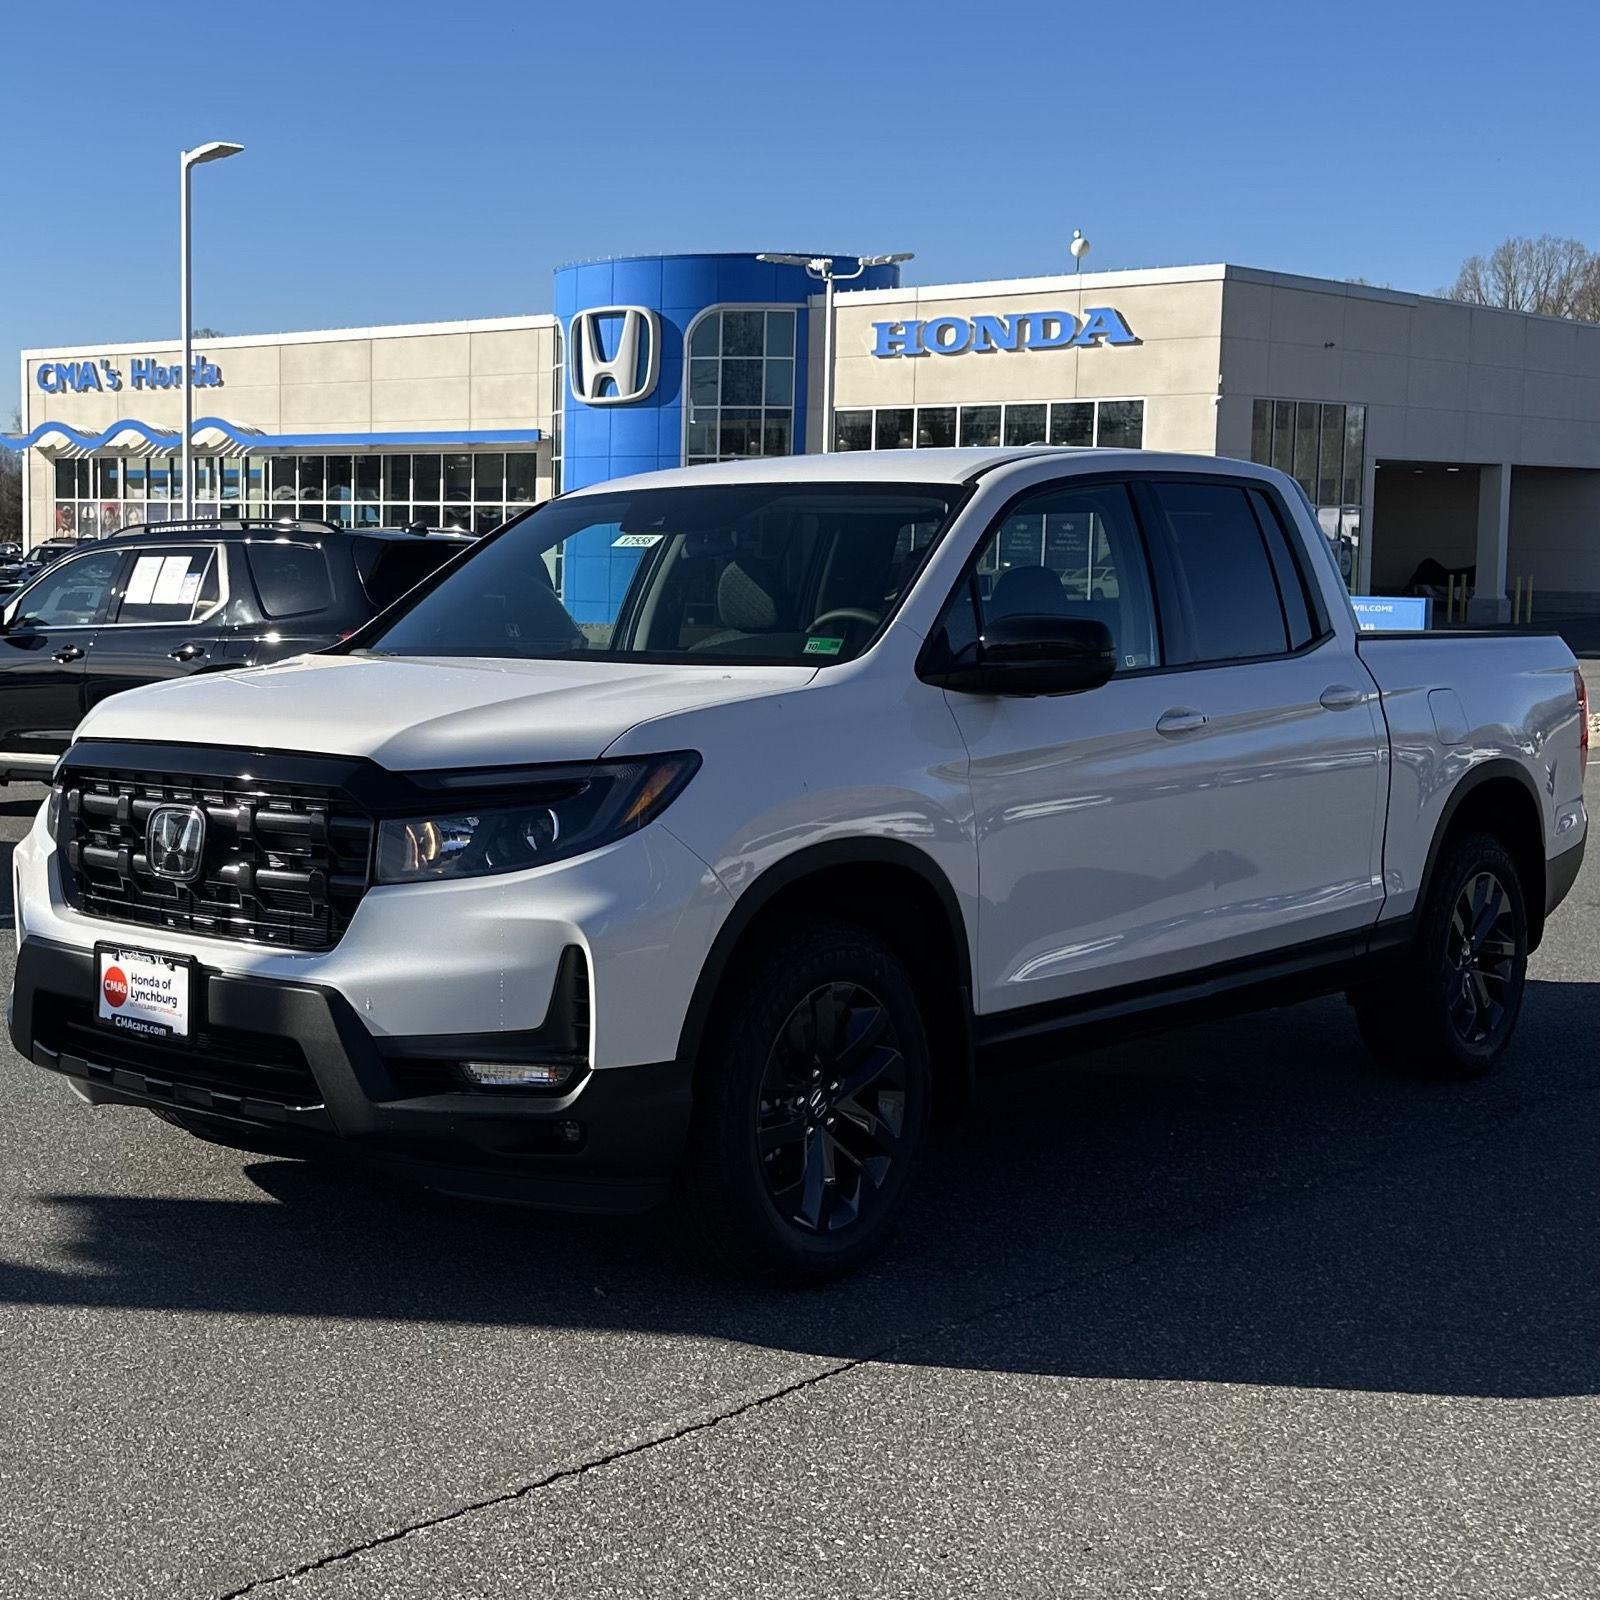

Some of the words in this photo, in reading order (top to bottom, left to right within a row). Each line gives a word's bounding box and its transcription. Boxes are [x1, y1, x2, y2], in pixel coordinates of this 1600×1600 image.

[871, 307, 1138, 357] HONDA
[37, 360, 121, 392] CMA's
[1353, 604, 1393, 612] WELCOME
[104, 980, 127, 994] CMA's
[131, 972, 160, 989] Honda
[162, 979, 172, 990] of
[131, 986, 178, 1009] Lynchburg
[115, 1016, 167, 1036] CMAcars.com
